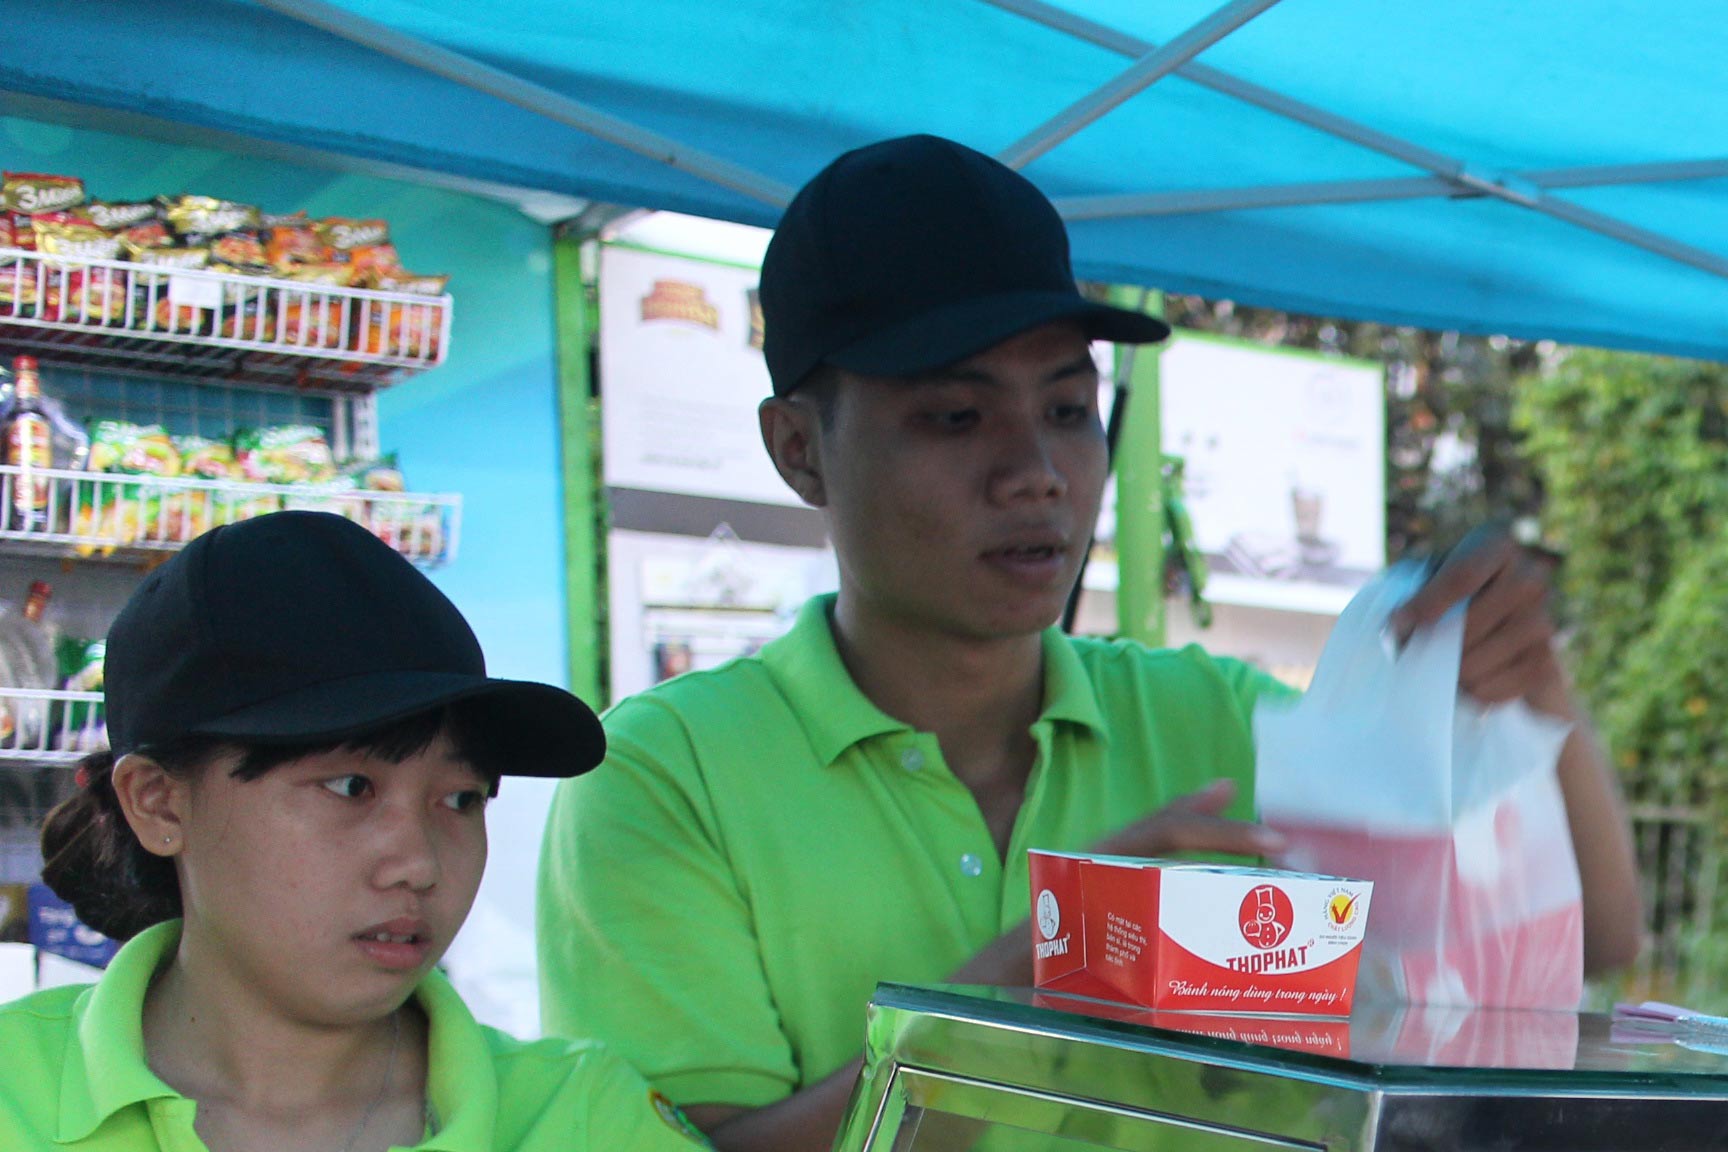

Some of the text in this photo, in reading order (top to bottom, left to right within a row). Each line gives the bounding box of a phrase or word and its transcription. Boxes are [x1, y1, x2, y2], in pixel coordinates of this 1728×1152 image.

[1168, 980, 1208, 996] Bánh
[1210, 985, 1242, 1001] nóng
[1243, 984, 1275, 1003] dùng
[1275, 988, 1307, 1004] trong
[1307, 990, 1338, 1006] ngày
